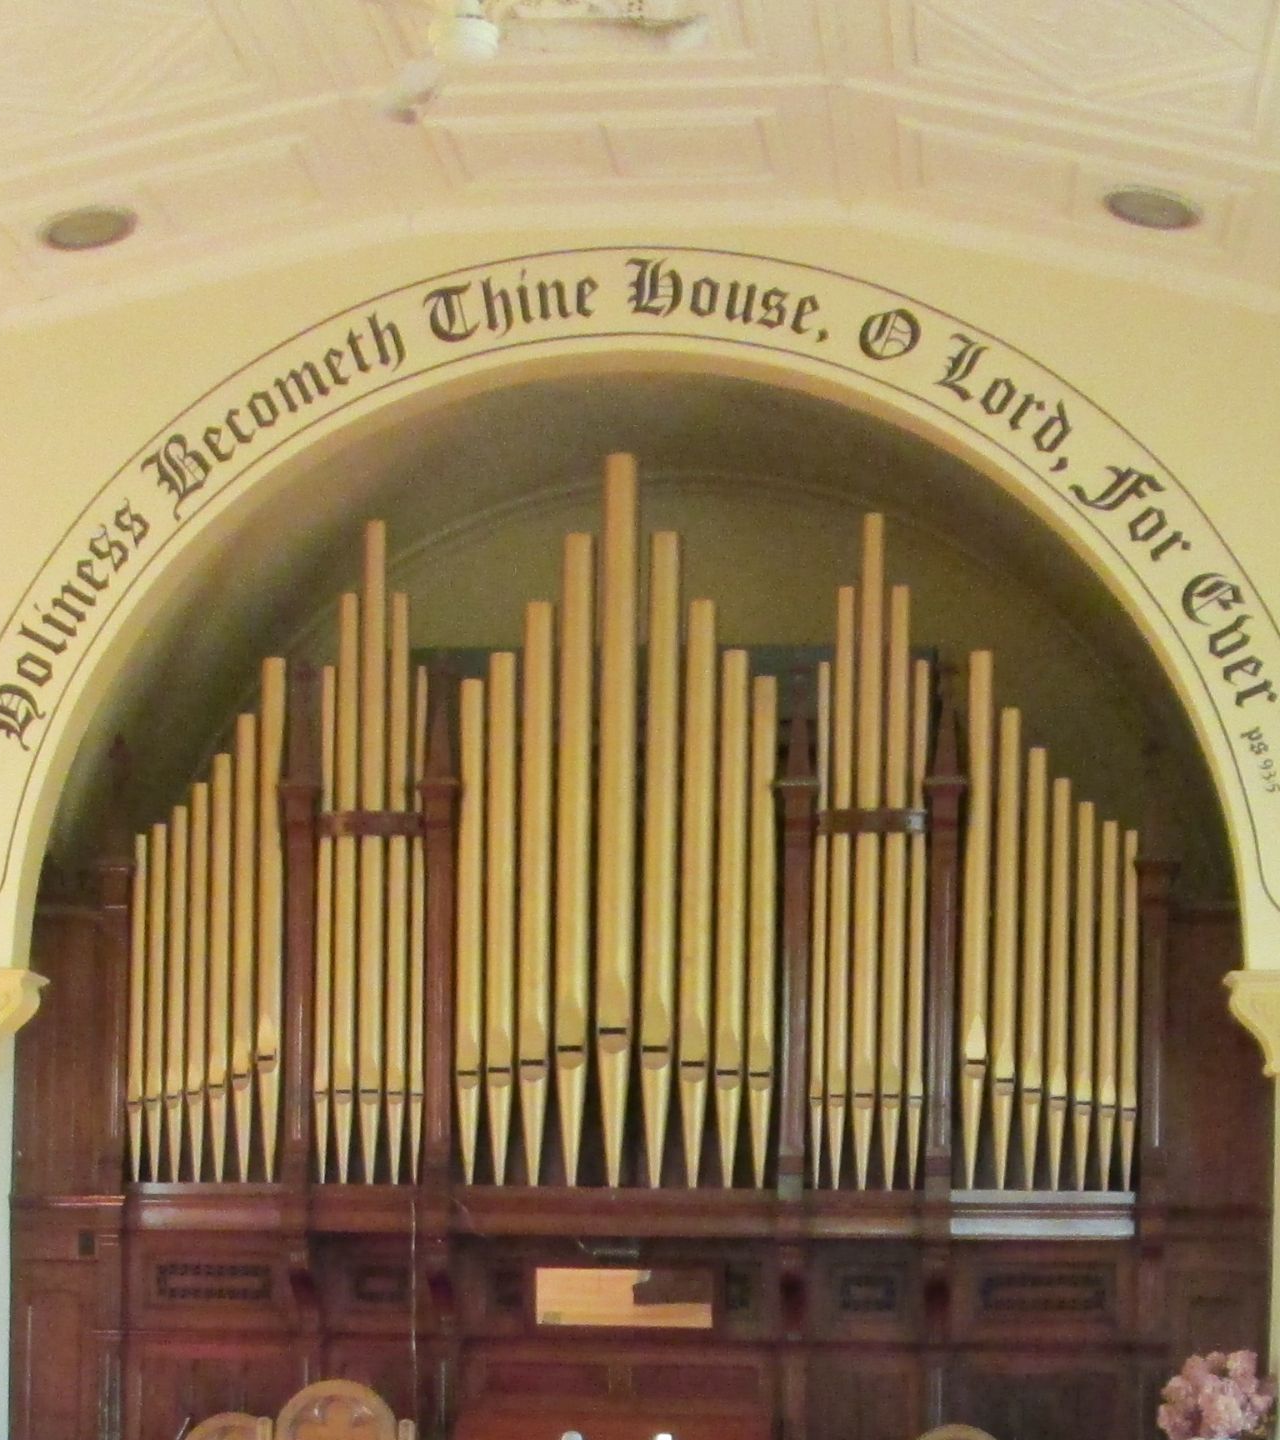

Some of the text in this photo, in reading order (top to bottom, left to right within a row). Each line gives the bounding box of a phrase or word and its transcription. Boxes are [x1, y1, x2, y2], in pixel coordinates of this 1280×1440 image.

[141, 313, 406, 521] Becometh
[423, 276, 599, 343] Thine
[625, 258, 829, 344] House,
[859, 309, 921, 360] O
[935, 333, 1072, 473] Lord,
[1069, 466, 1193, 563] For
